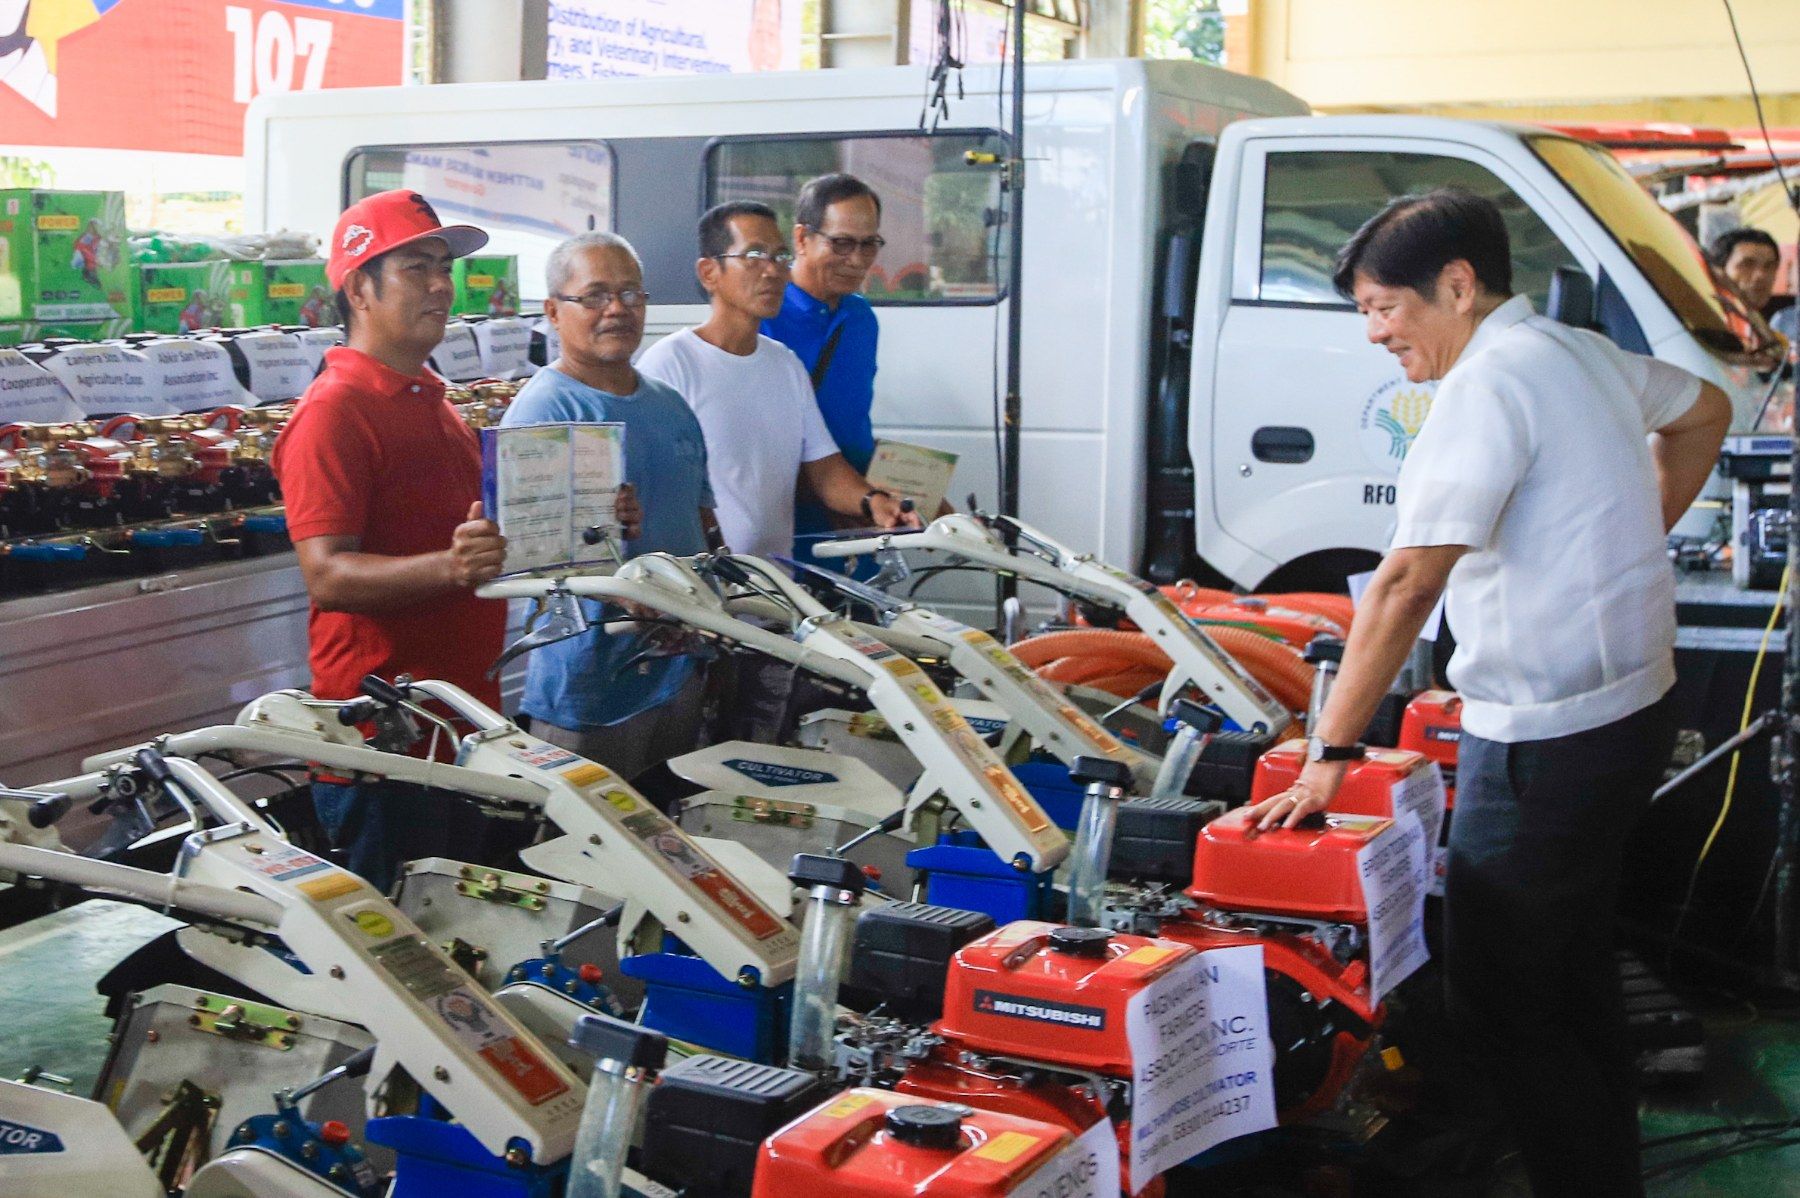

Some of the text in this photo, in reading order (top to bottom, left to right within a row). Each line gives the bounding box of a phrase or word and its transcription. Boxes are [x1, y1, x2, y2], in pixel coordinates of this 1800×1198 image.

[225, 6, 333, 104] 107
[569, 38, 592, 55] and
[1363, 485, 1396, 504] RFO
[737, 761, 823, 780] CULTIVATOR
[994, 1000, 1101, 1026] MITSUBISHI
